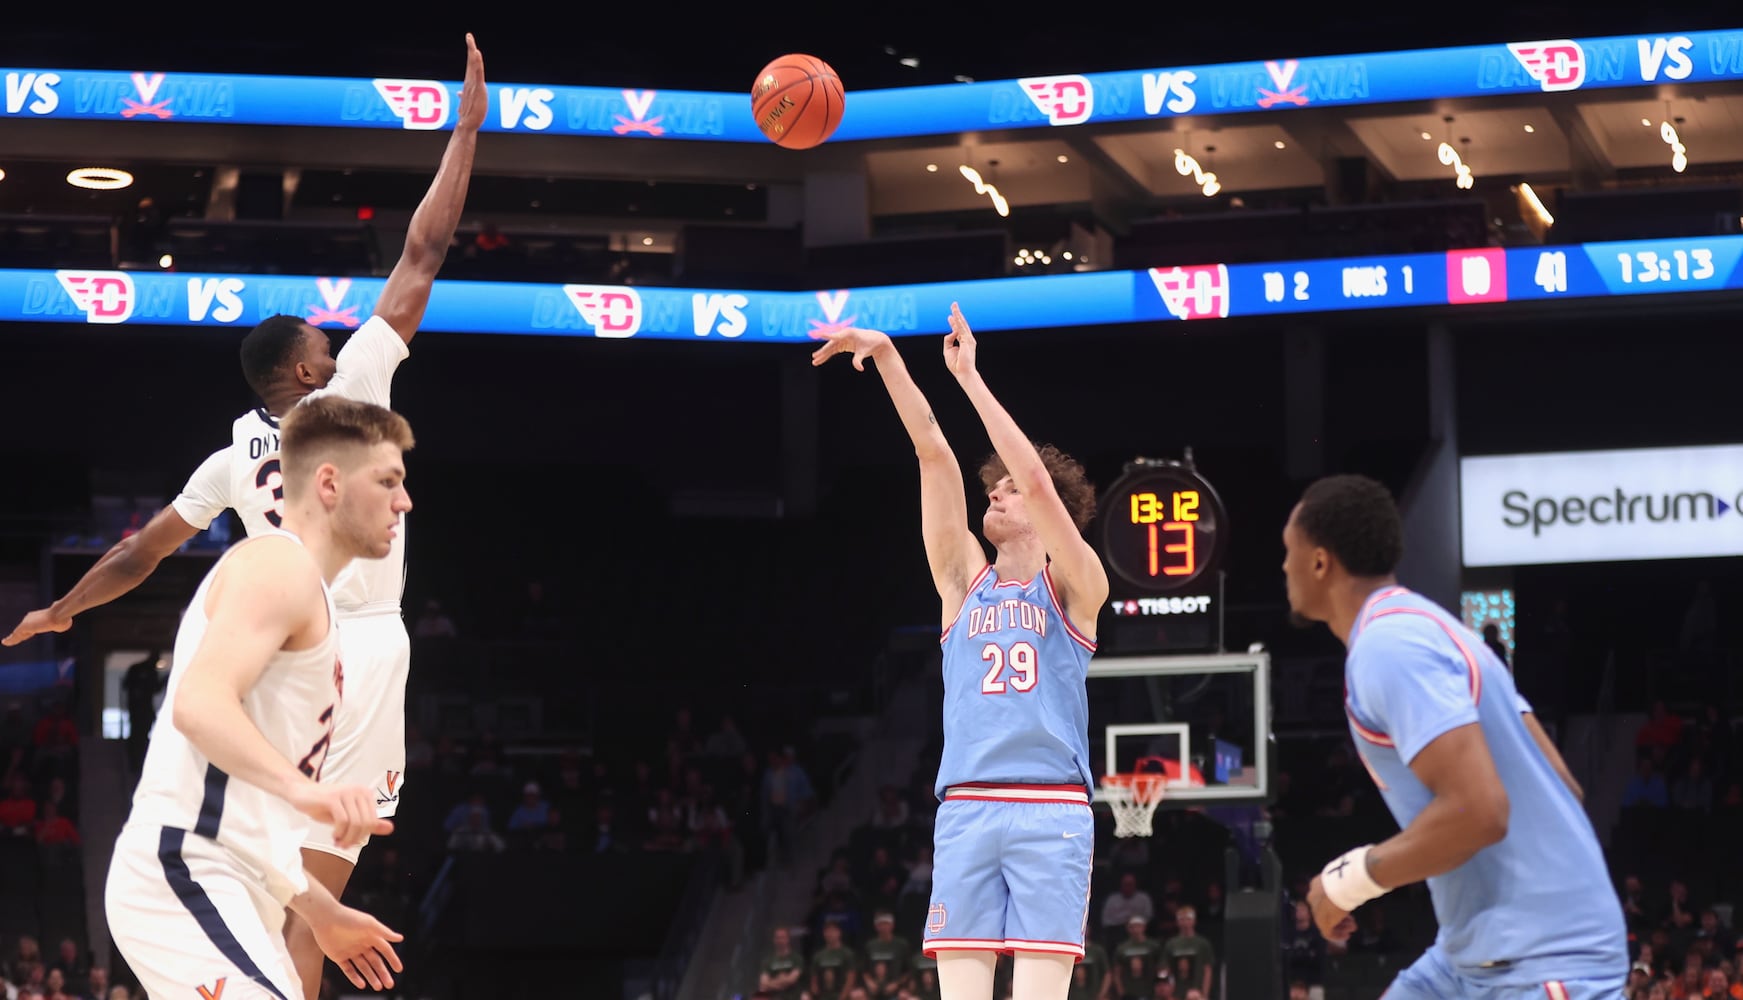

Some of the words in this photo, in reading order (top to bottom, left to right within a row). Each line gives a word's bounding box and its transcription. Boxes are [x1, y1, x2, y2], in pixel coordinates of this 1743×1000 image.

[1637, 36, 1694, 81] VS
[5, 72, 61, 115] VS
[74, 78, 236, 117] VIRNIA
[499, 87, 555, 130] VS
[1142, 70, 1197, 115] VS
[1210, 61, 1369, 108] VIRNIA
[1294, 271, 1309, 300] 2
[1402, 265, 1413, 294] 1
[1534, 250, 1567, 292] 41
[1617, 248, 1714, 283] 13:13
[22, 279, 177, 318] DAON
[187, 277, 245, 322] VS
[692, 293, 748, 337] VS
[1131, 491, 1199, 524] 13:12
[1502, 487, 1718, 538] Spectrum
[1149, 521, 1195, 577] 13
[968, 599, 1047, 640] DAYTON
[1138, 596, 1210, 615] TISSOT
[981, 641, 1038, 695] 29
